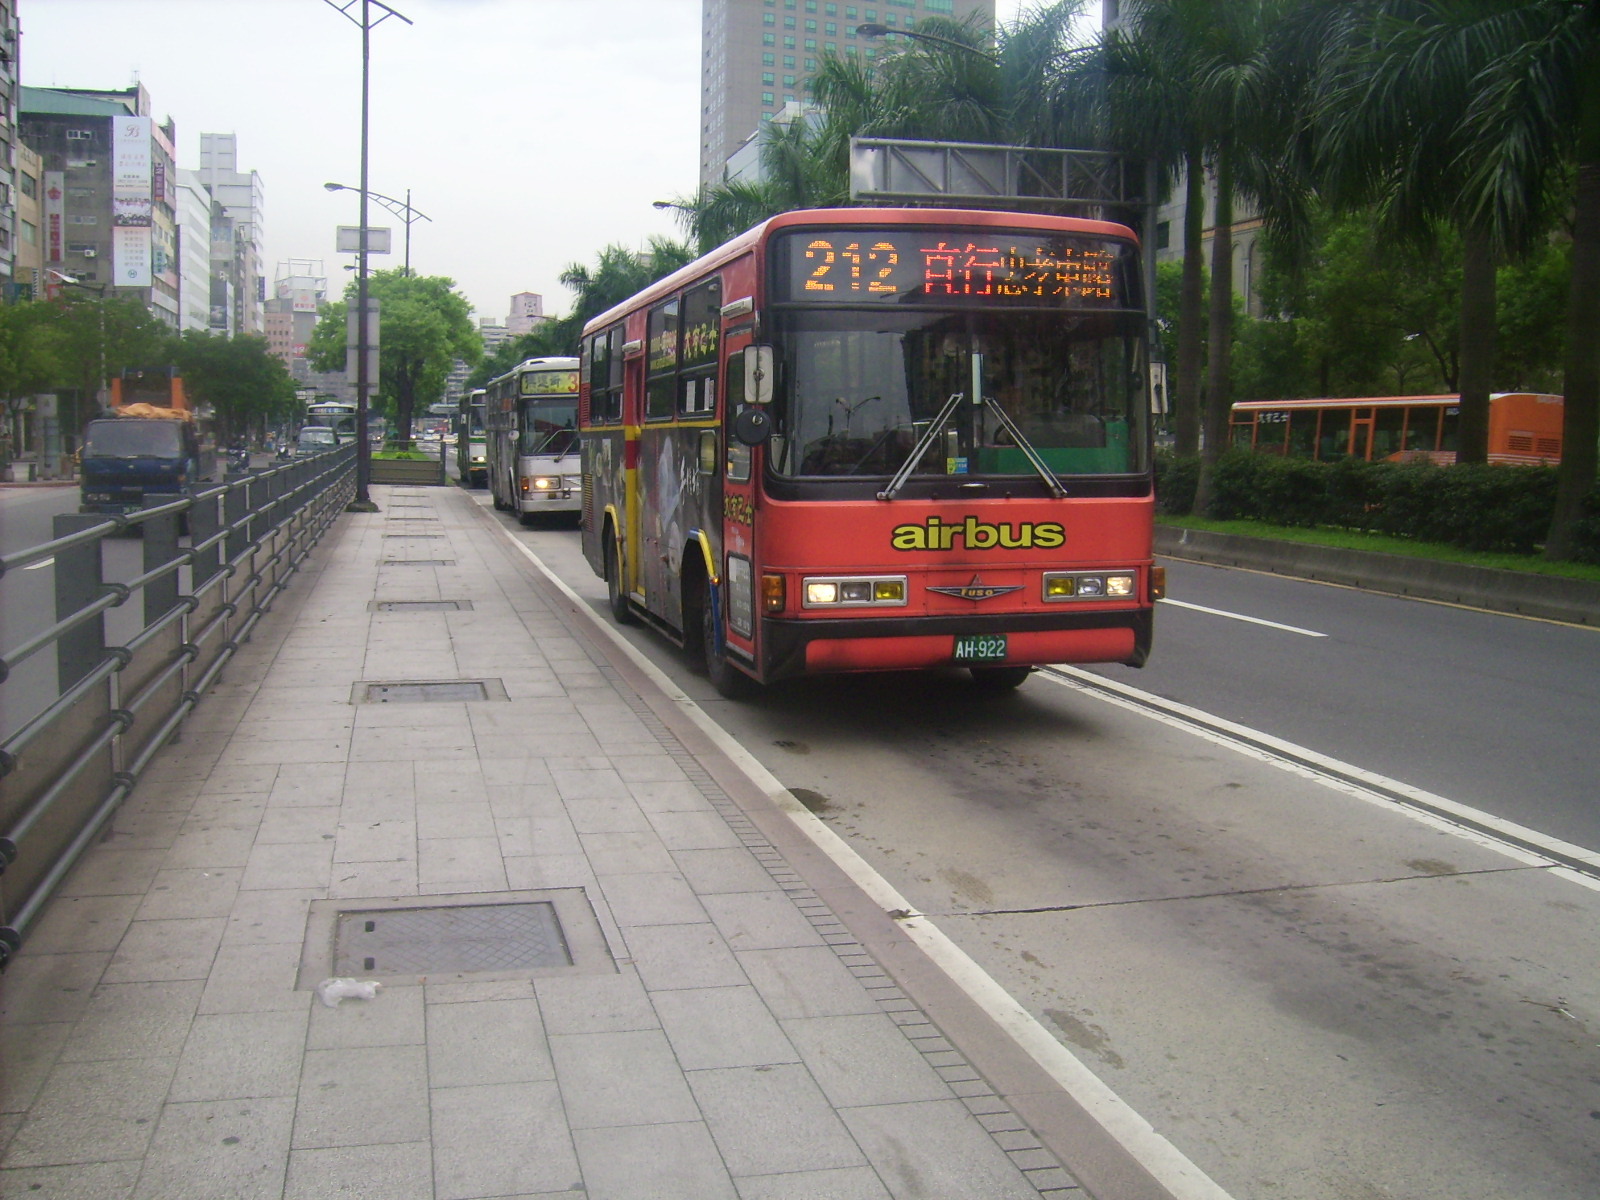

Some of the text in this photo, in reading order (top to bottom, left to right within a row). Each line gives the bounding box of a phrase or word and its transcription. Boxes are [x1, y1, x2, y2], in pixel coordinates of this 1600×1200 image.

[804, 240, 898, 292] 212
[891, 516, 1066, 550] airbus
[955, 640, 1006, 658] AH-922
